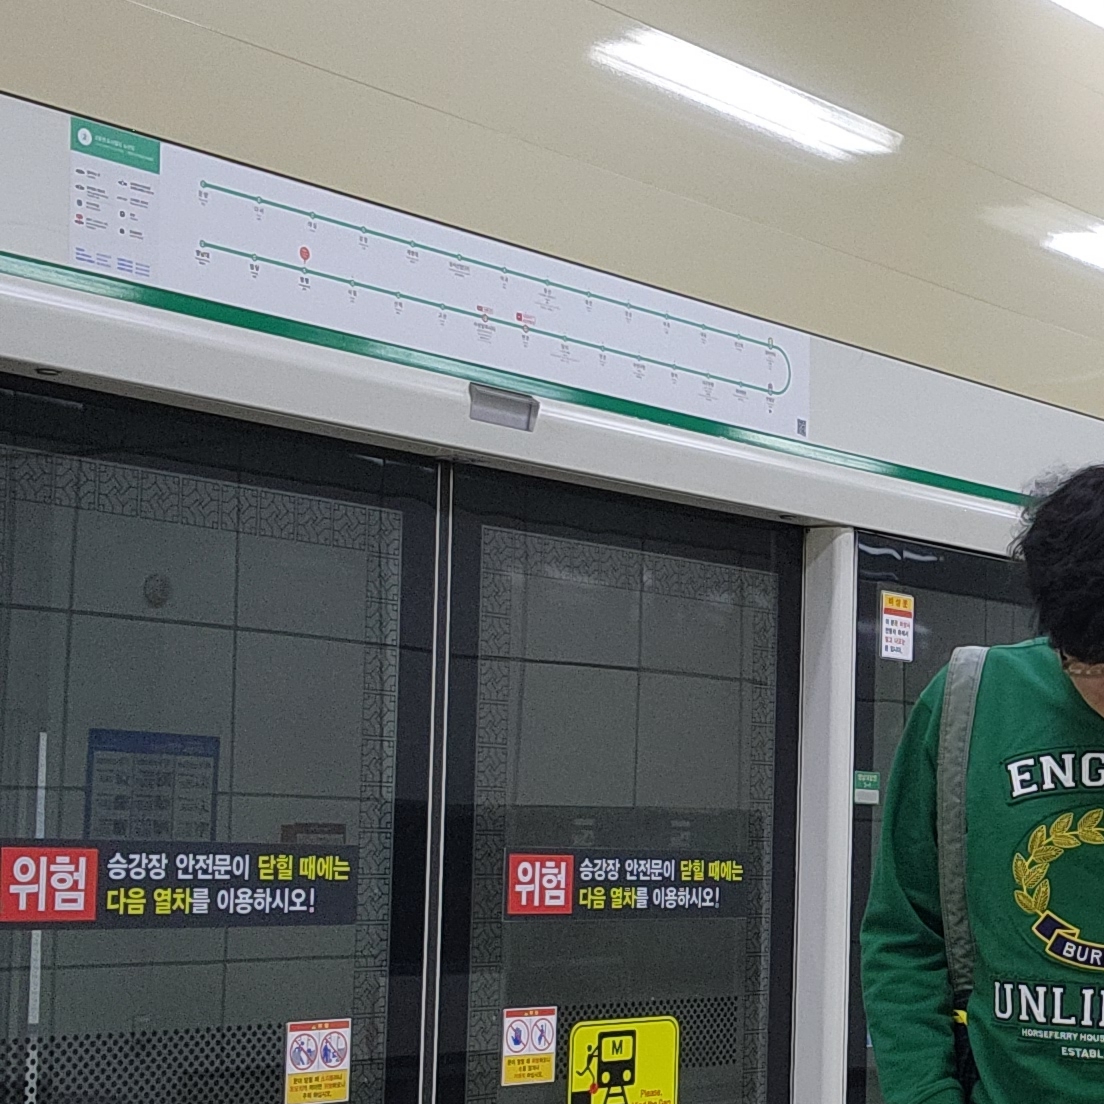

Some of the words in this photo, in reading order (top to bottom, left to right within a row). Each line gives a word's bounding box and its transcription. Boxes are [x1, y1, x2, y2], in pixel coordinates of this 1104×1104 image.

[106, 853, 168, 880] 승강장
[176, 853, 250, 880] 안전문이
[258, 854, 294, 880] 닫힐
[300, 855, 351, 881] 때에는
[579, 859, 620, 881] 승강장
[625, 859, 675, 881] 안전문이
[680, 859, 705, 881] 닫힐
[708, 860, 744, 881] 때에는
[9, 856, 87, 912] 위험
[515, 861, 567, 907] 위험
[106, 887, 146, 915] 다음
[153, 887, 210, 915] 열차를
[217, 887, 316, 914] 이용하시오!
[579, 887, 606, 909] 다음
[611, 886, 649, 909] 열차를
[653, 886, 720, 909] 이용하시오!
[1021, 1027, 1078, 1041] HORSEFERRY
[612, 1040, 623, 1055] M
